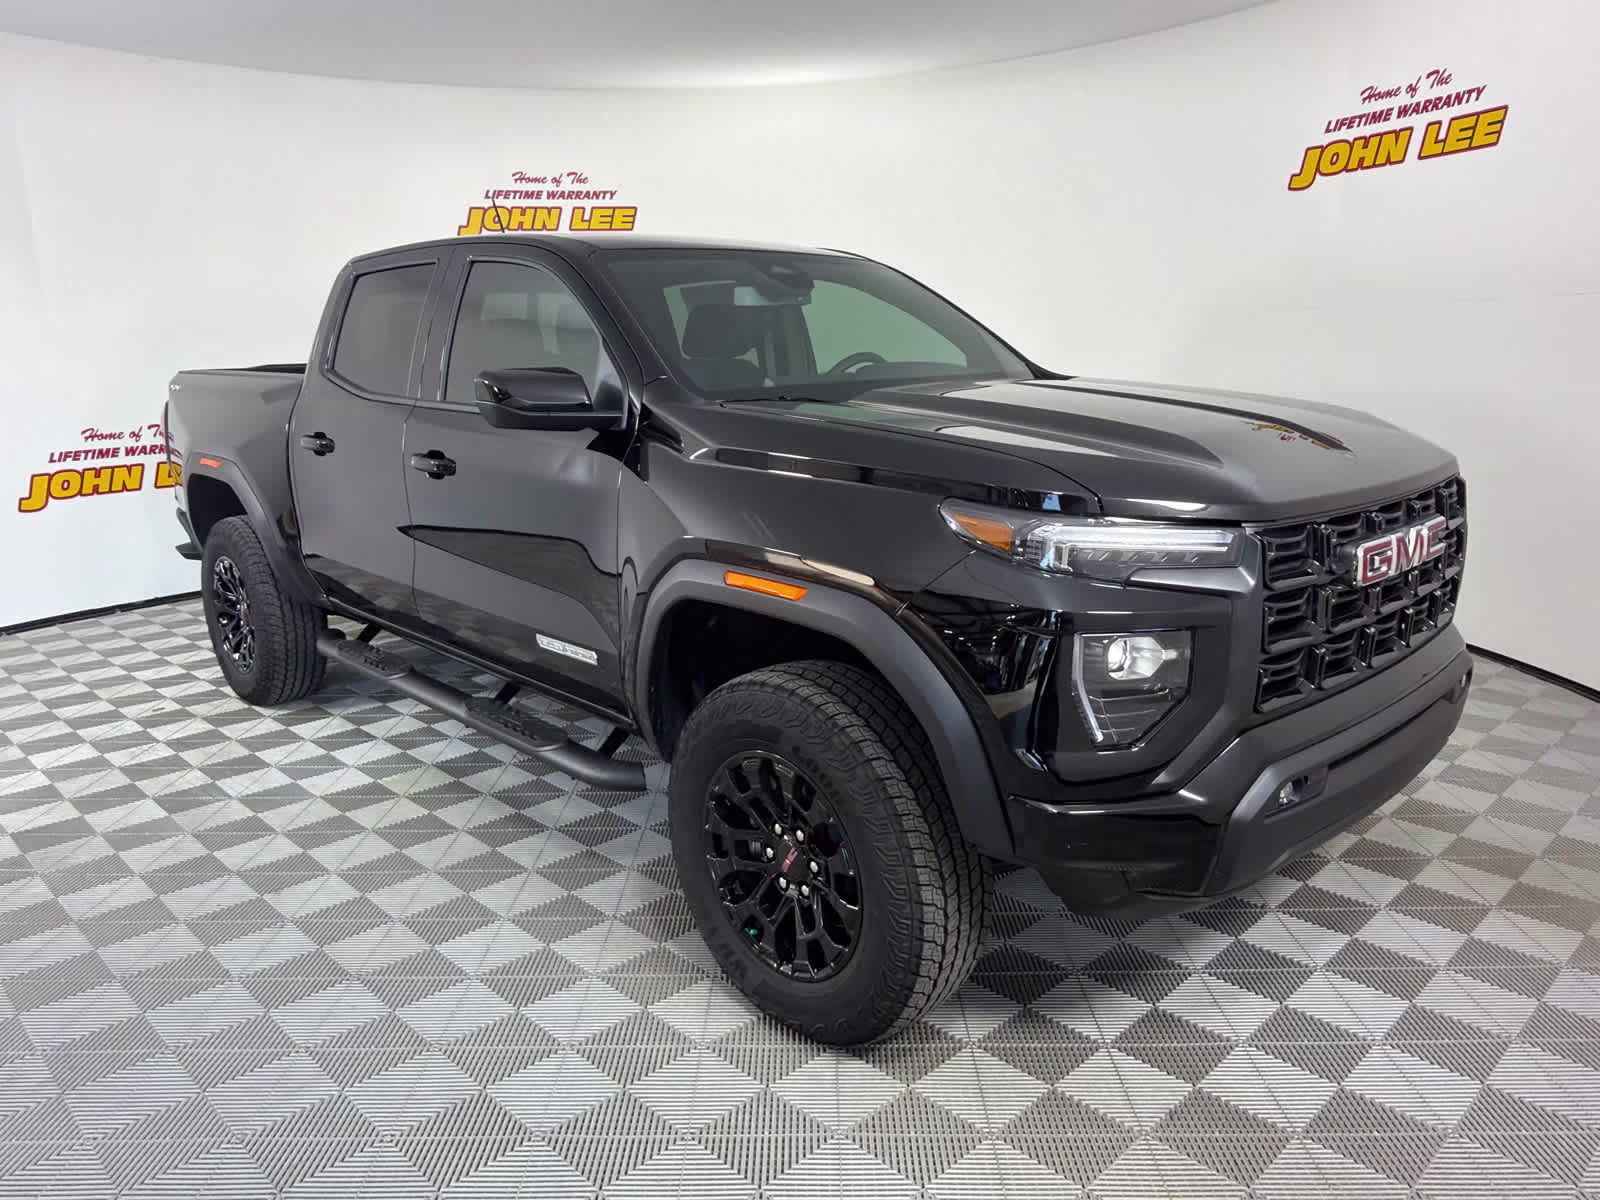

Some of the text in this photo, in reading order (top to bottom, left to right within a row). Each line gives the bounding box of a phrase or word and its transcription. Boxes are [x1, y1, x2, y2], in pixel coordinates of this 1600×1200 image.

[1360, 68, 1452, 105] Home of The
[1324, 85, 1487, 134] LIFETIME WARRANTY
[1287, 104, 1509, 191] JOHN LEE
[484, 189, 617, 200] LIFETIME WARRANTY
[511, 171, 589, 188] Home of The
[457, 206, 637, 236] JOHN LEE
[81, 427, 125, 443] Home
[128, 426, 143, 442] of
[48, 447, 121, 463] LIFETIME
[18, 463, 145, 513] JOHN
[1357, 515, 1447, 587] GMC
